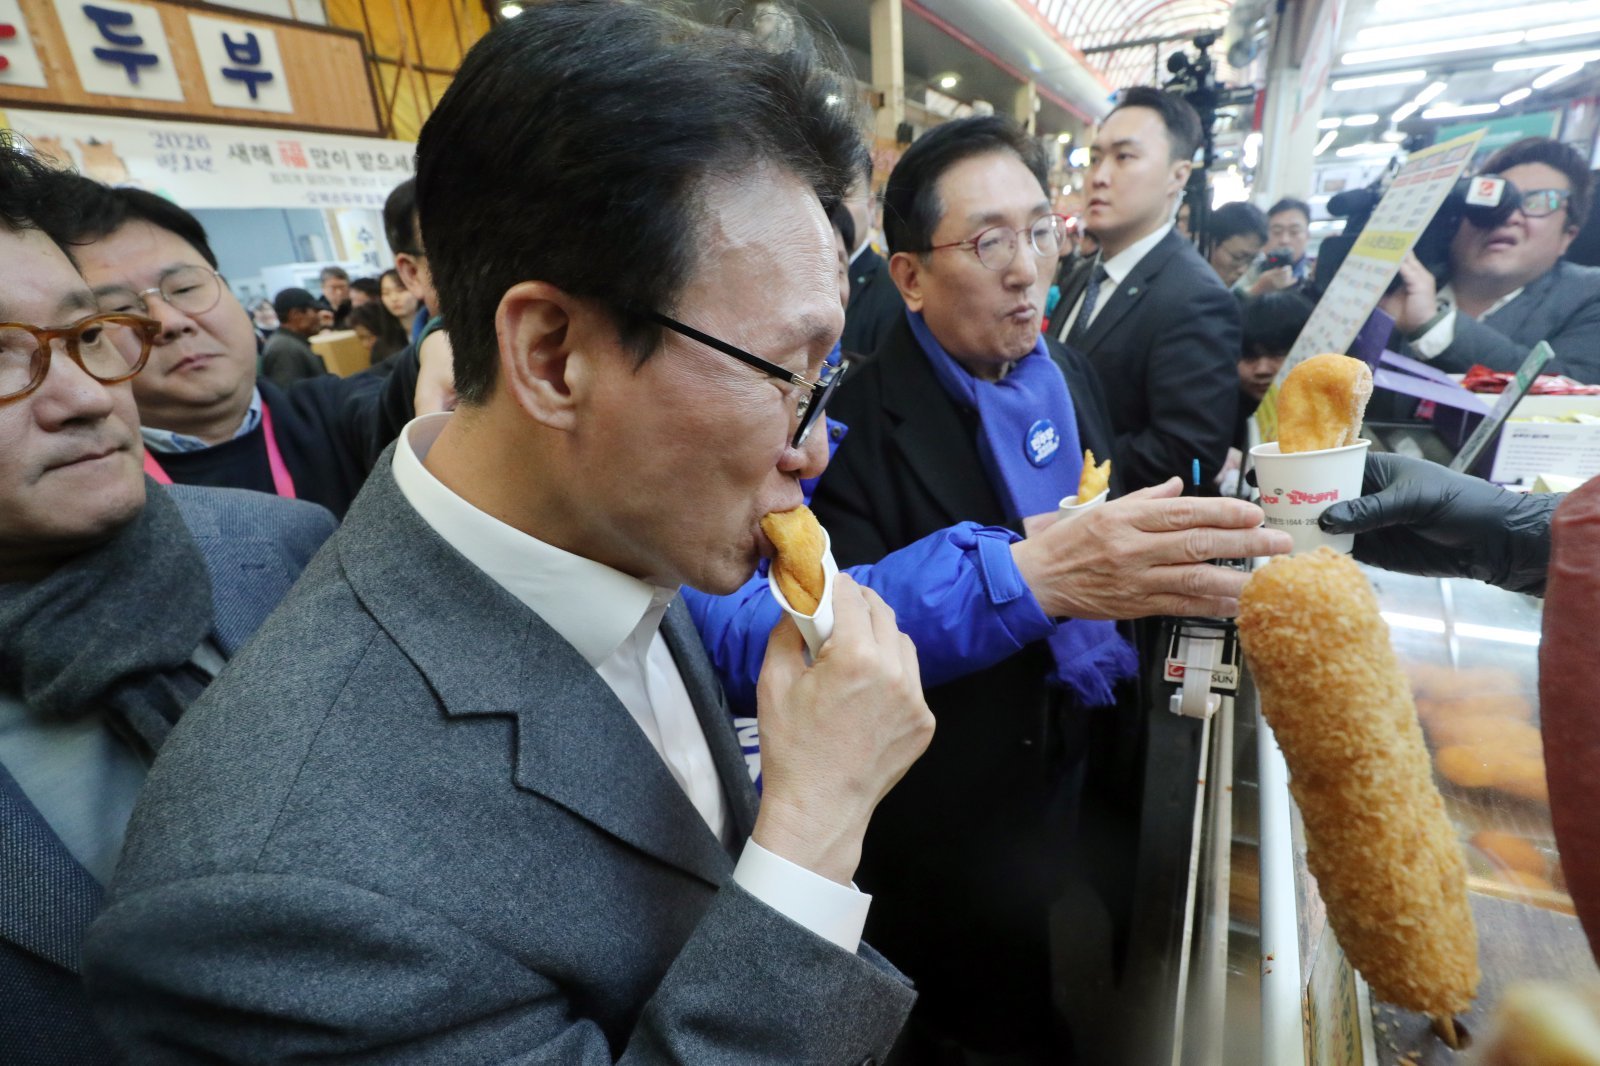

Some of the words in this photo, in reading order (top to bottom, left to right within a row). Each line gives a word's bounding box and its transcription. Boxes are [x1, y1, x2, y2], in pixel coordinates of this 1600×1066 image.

[149, 131, 211, 150] 2026
[228, 141, 273, 165] 새해
[309, 147, 351, 170] 많이
